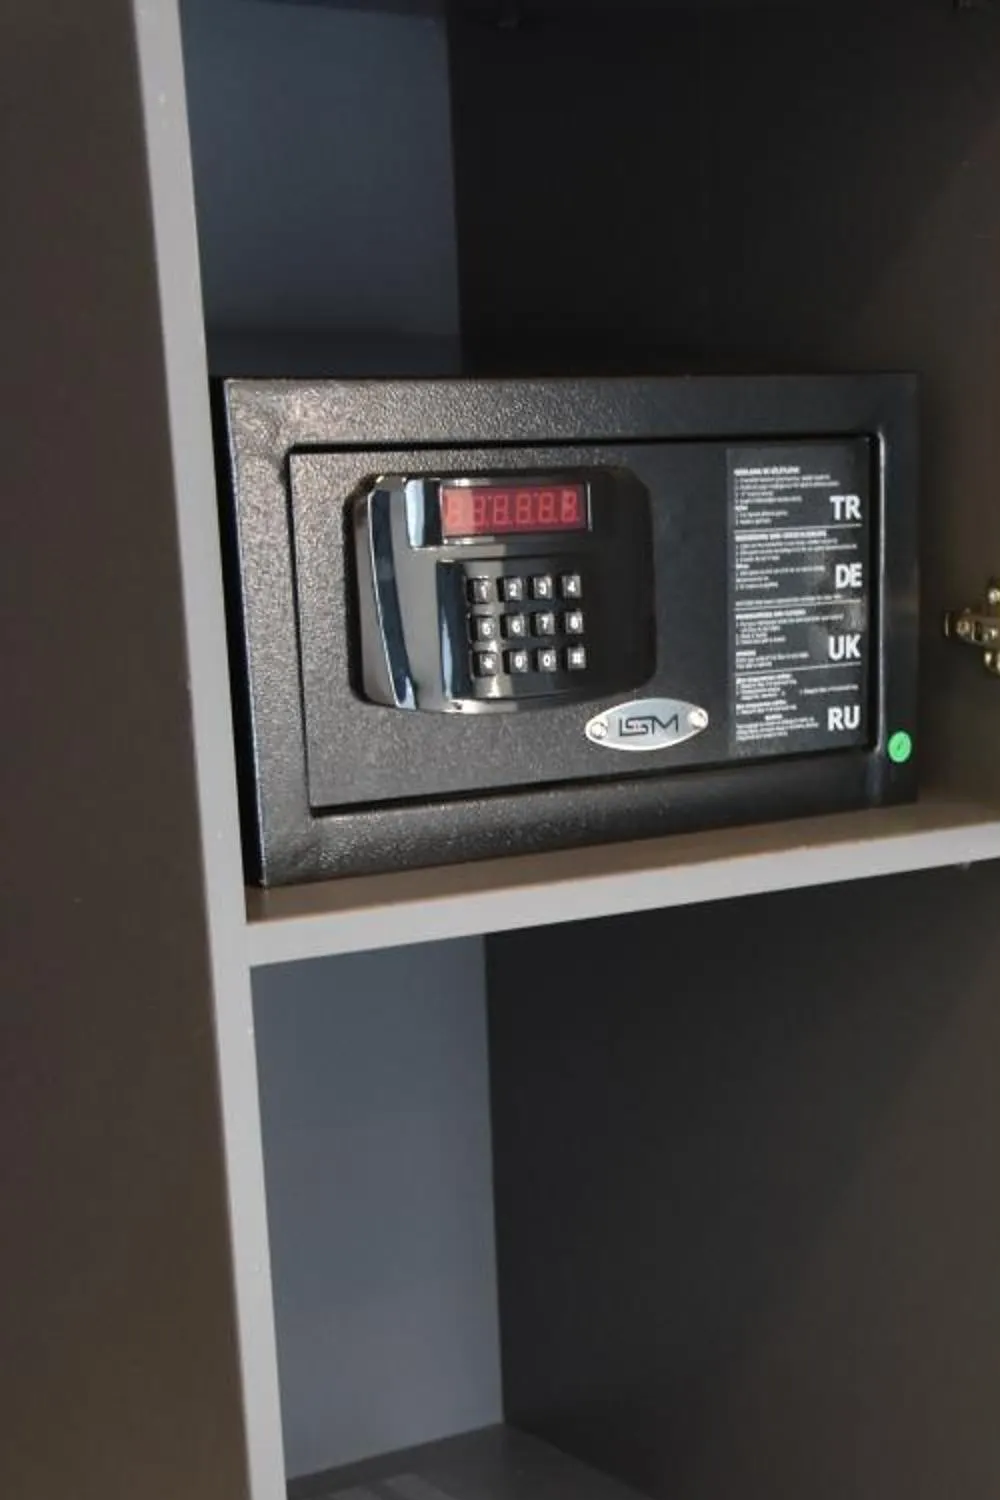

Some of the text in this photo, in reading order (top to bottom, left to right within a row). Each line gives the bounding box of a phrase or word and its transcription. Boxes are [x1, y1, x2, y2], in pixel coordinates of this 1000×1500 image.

[829, 494, 862, 520] TR
[835, 563, 862, 588] DE
[509, 583, 517, 597] 2
[567, 581, 576, 593] 4
[828, 634, 861, 660] UK
[543, 653, 551, 667] 0
[827, 705, 860, 731] RU
